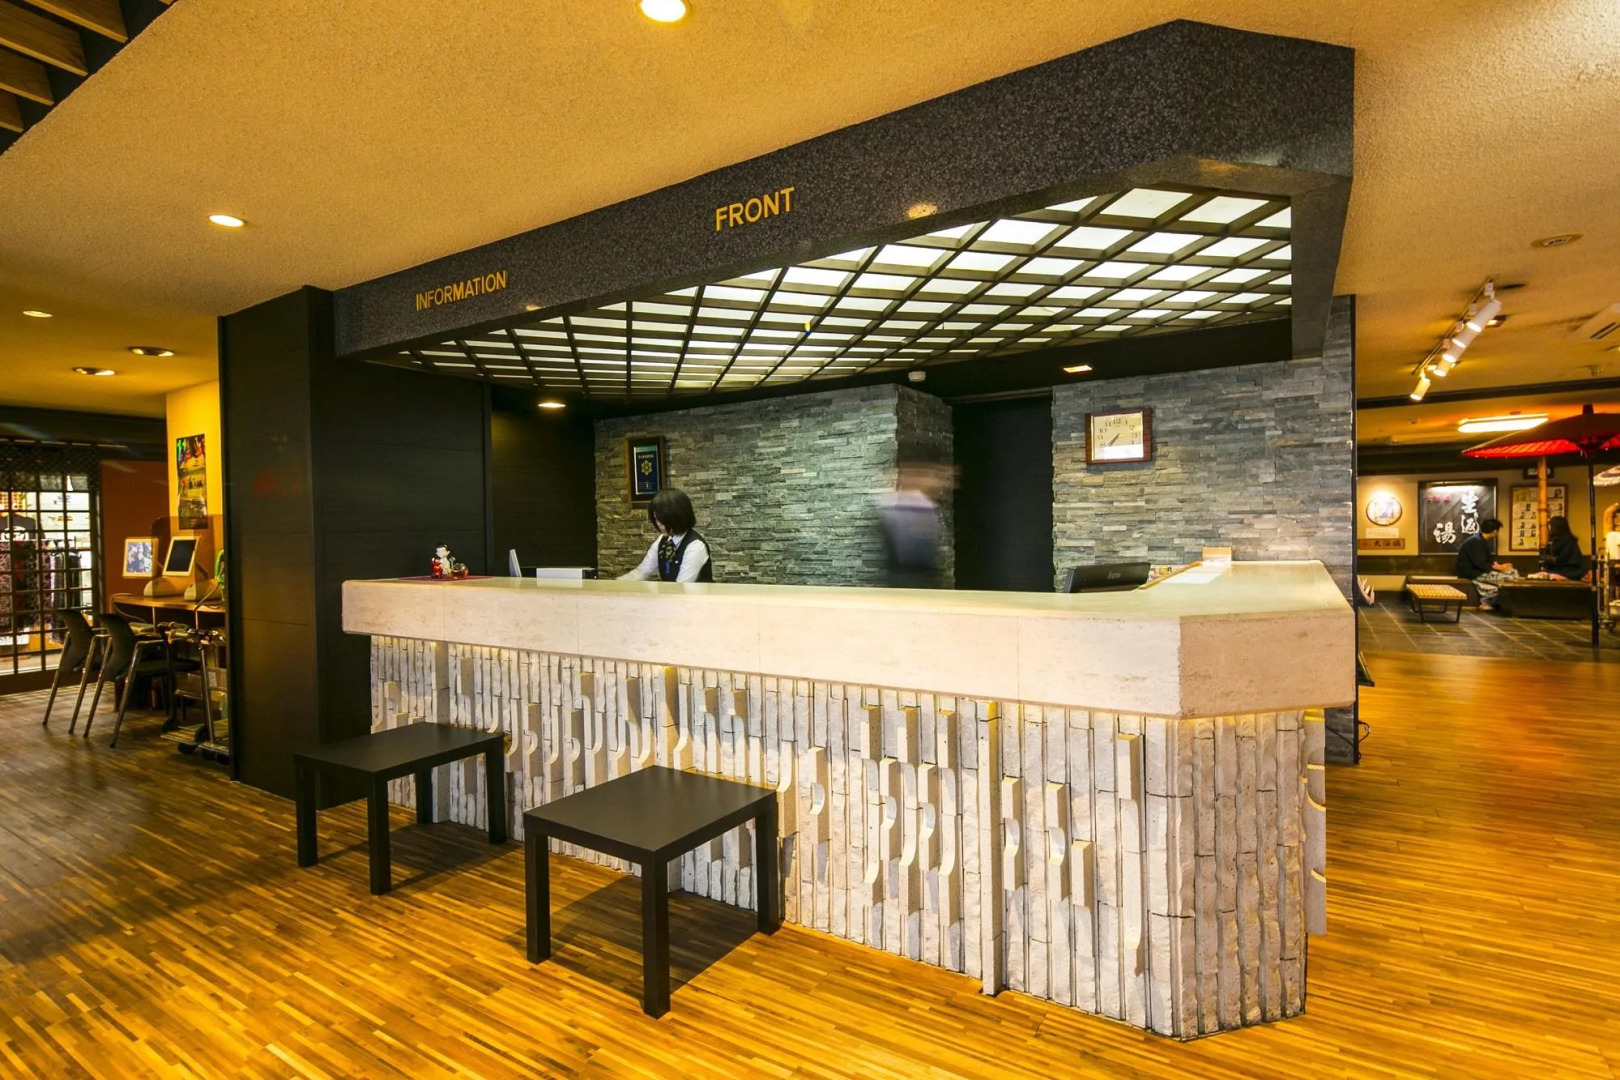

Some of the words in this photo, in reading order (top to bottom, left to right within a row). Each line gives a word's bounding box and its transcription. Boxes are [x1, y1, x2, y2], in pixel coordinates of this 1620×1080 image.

[716, 187, 795, 231] FRONT
[416, 270, 507, 311] INFORMATION
[1433, 521, 1456, 544] 湯
